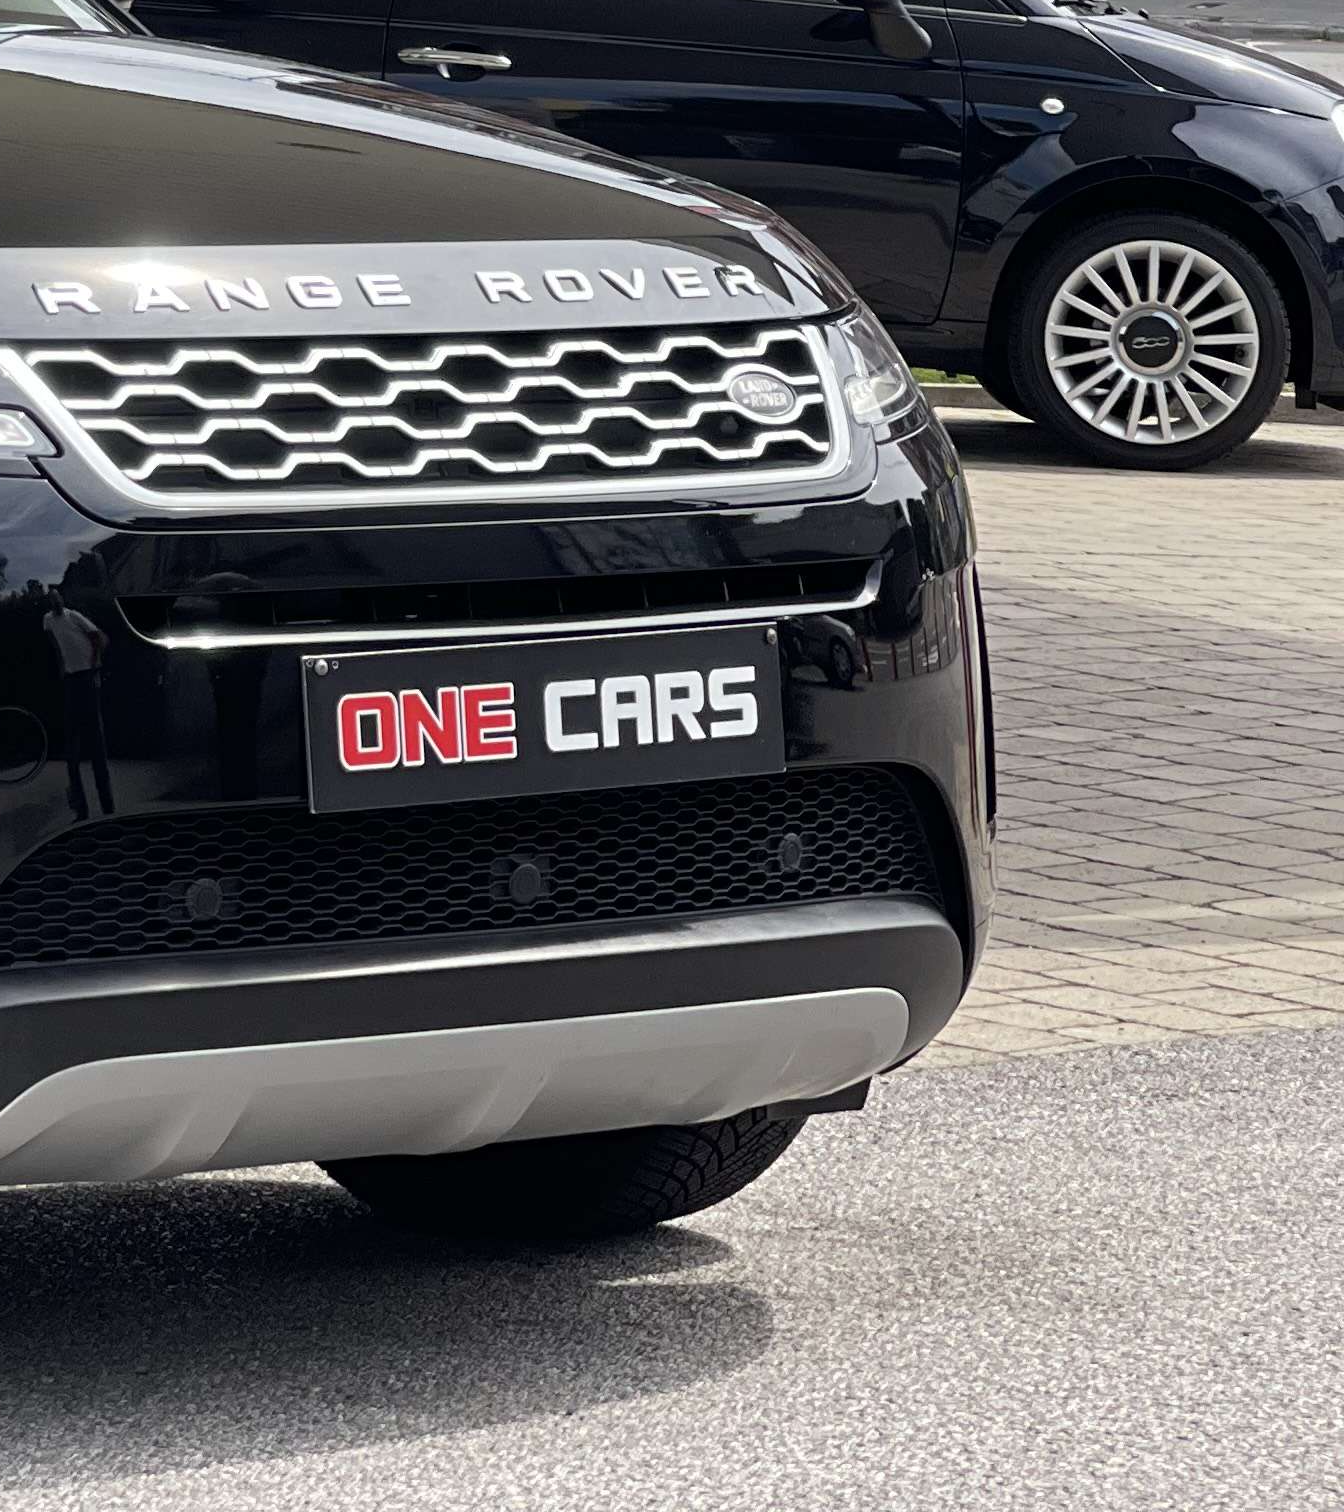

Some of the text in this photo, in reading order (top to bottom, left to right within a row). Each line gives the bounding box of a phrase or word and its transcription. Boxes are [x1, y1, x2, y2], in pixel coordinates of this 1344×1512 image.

[31, 264, 764, 315] RANGE ROVER
[337, 665, 758, 772] ONE CARS
